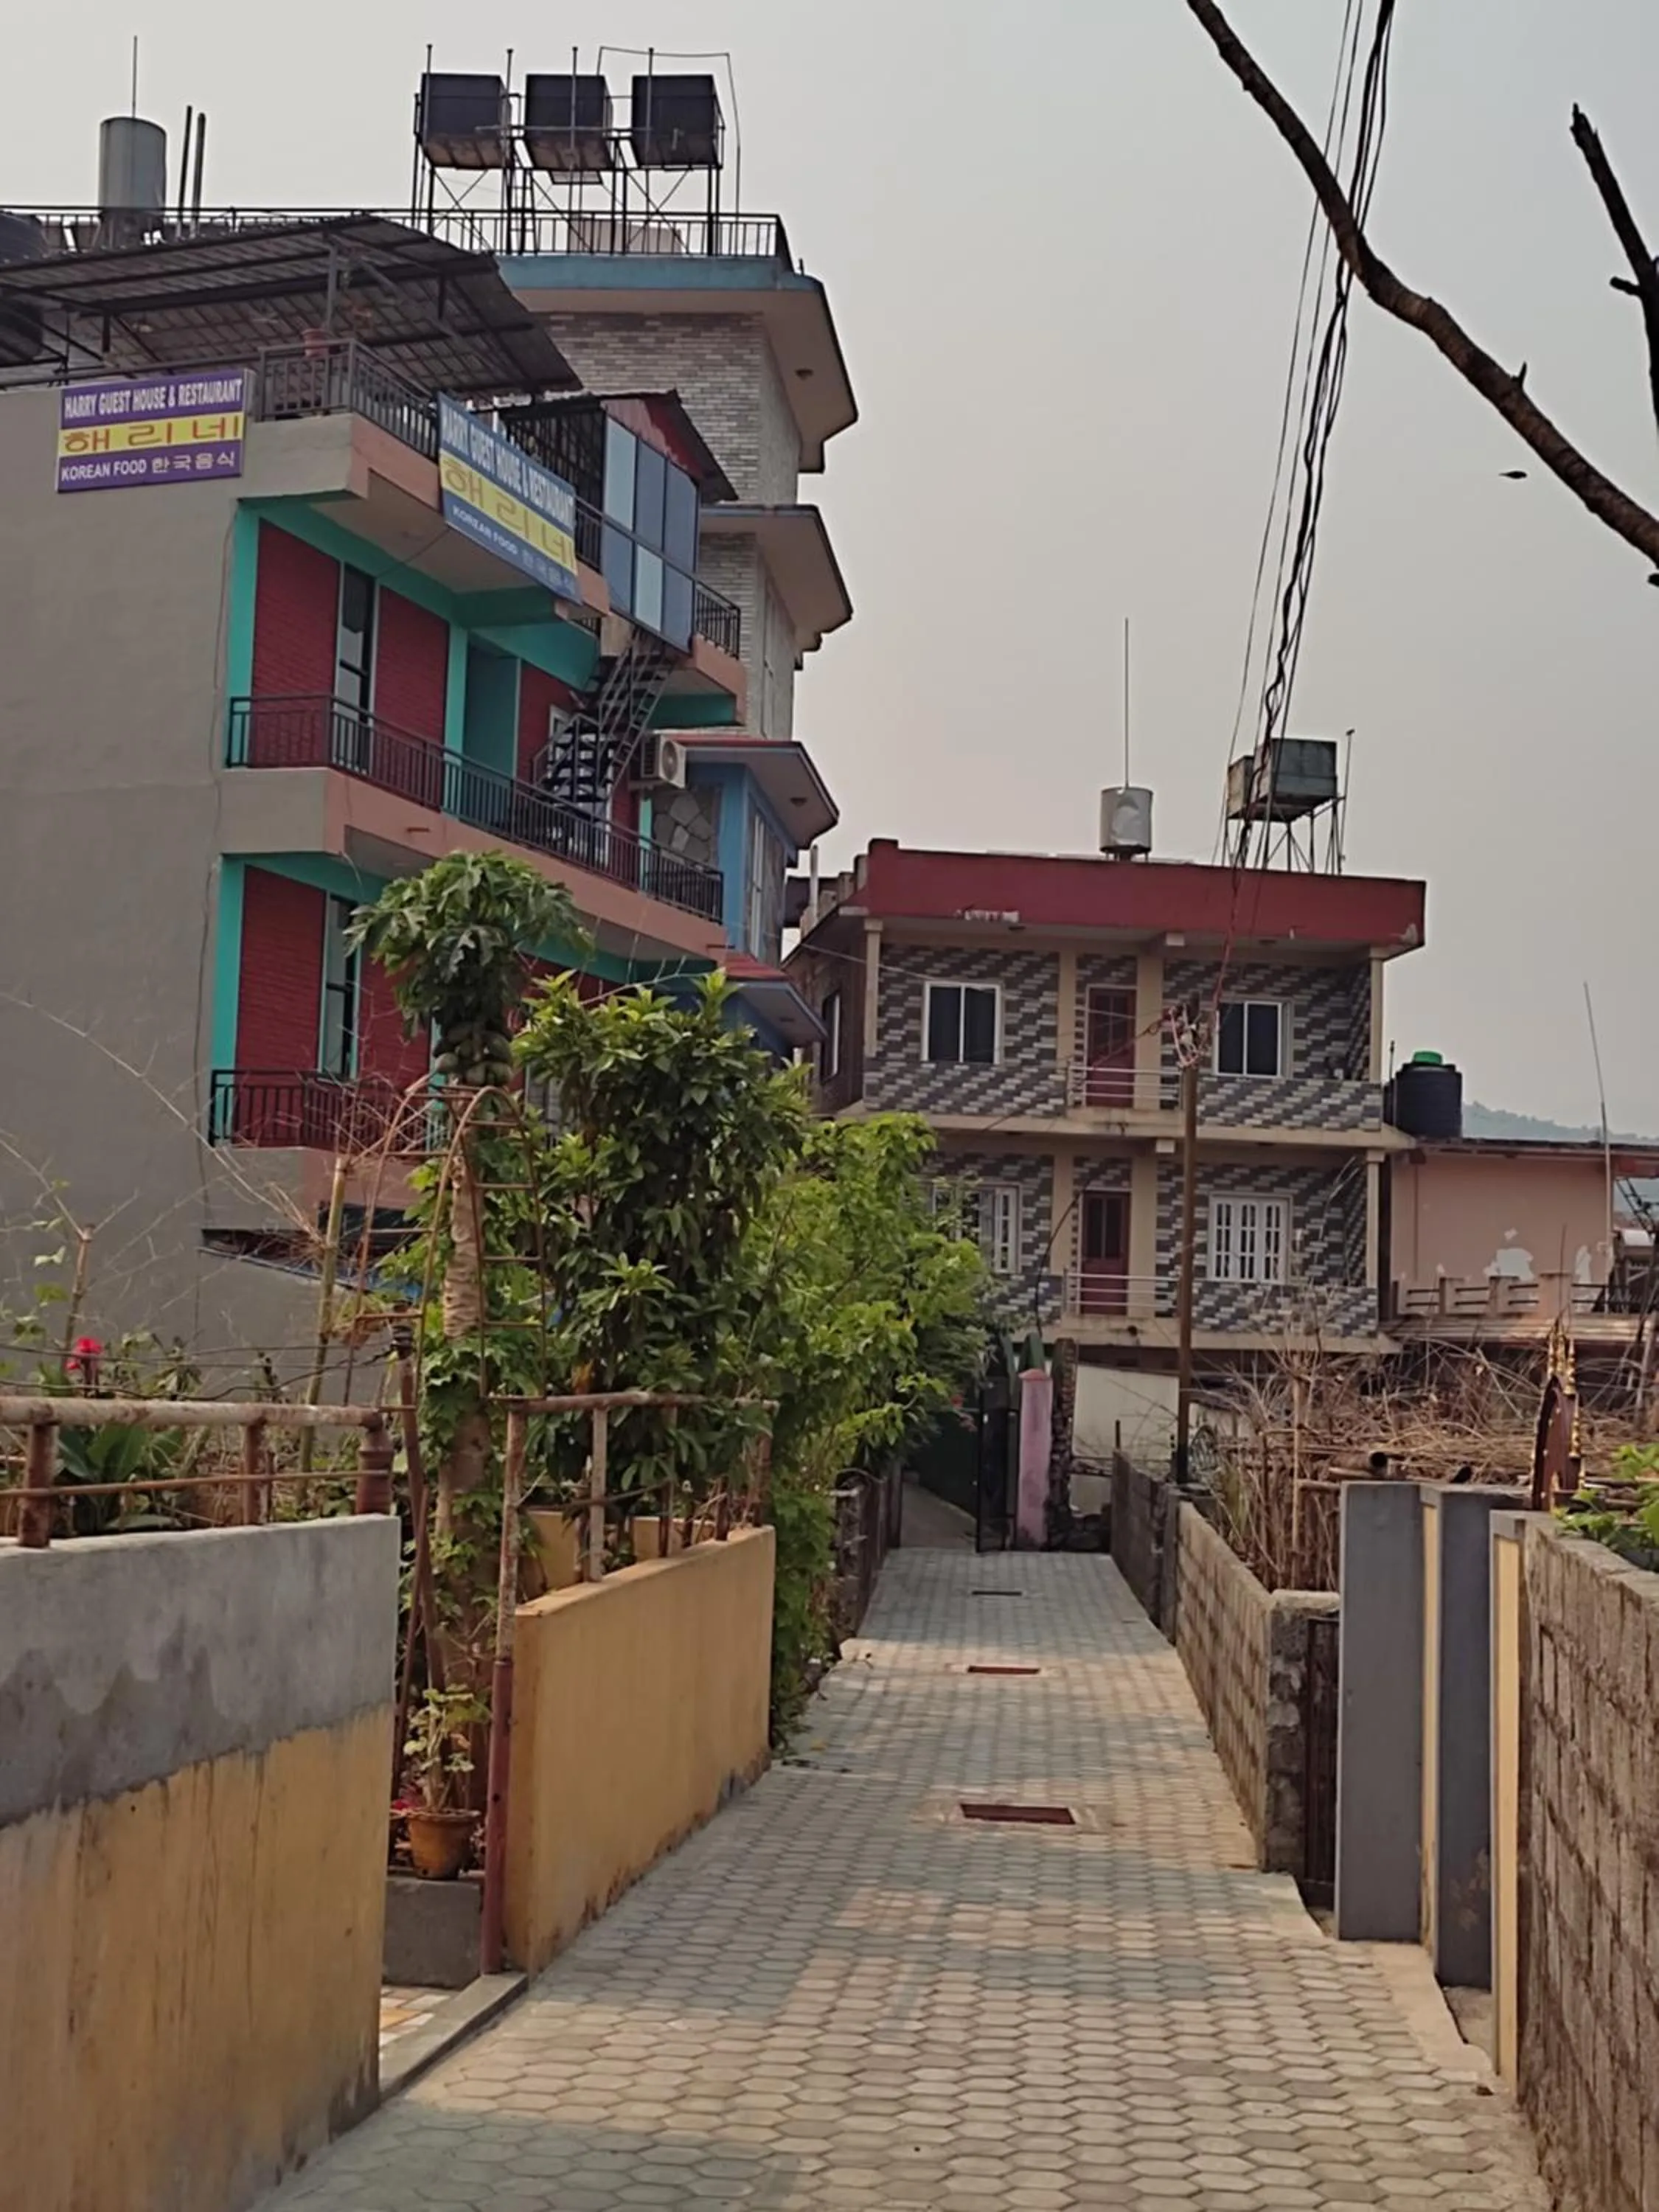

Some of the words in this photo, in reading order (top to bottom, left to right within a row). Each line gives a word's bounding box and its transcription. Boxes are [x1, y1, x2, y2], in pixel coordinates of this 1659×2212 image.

[64, 395, 97, 419] HARRY
[99, 389, 132, 415] GUEST
[133, 386, 166, 411] HOUSE
[168, 385, 175, 407] &
[178, 378, 243, 407] RESTAURANT
[61, 463, 111, 481] KOREAN
[113, 459, 147, 476] FOOD
[152, 451, 235, 473] 한국음식
